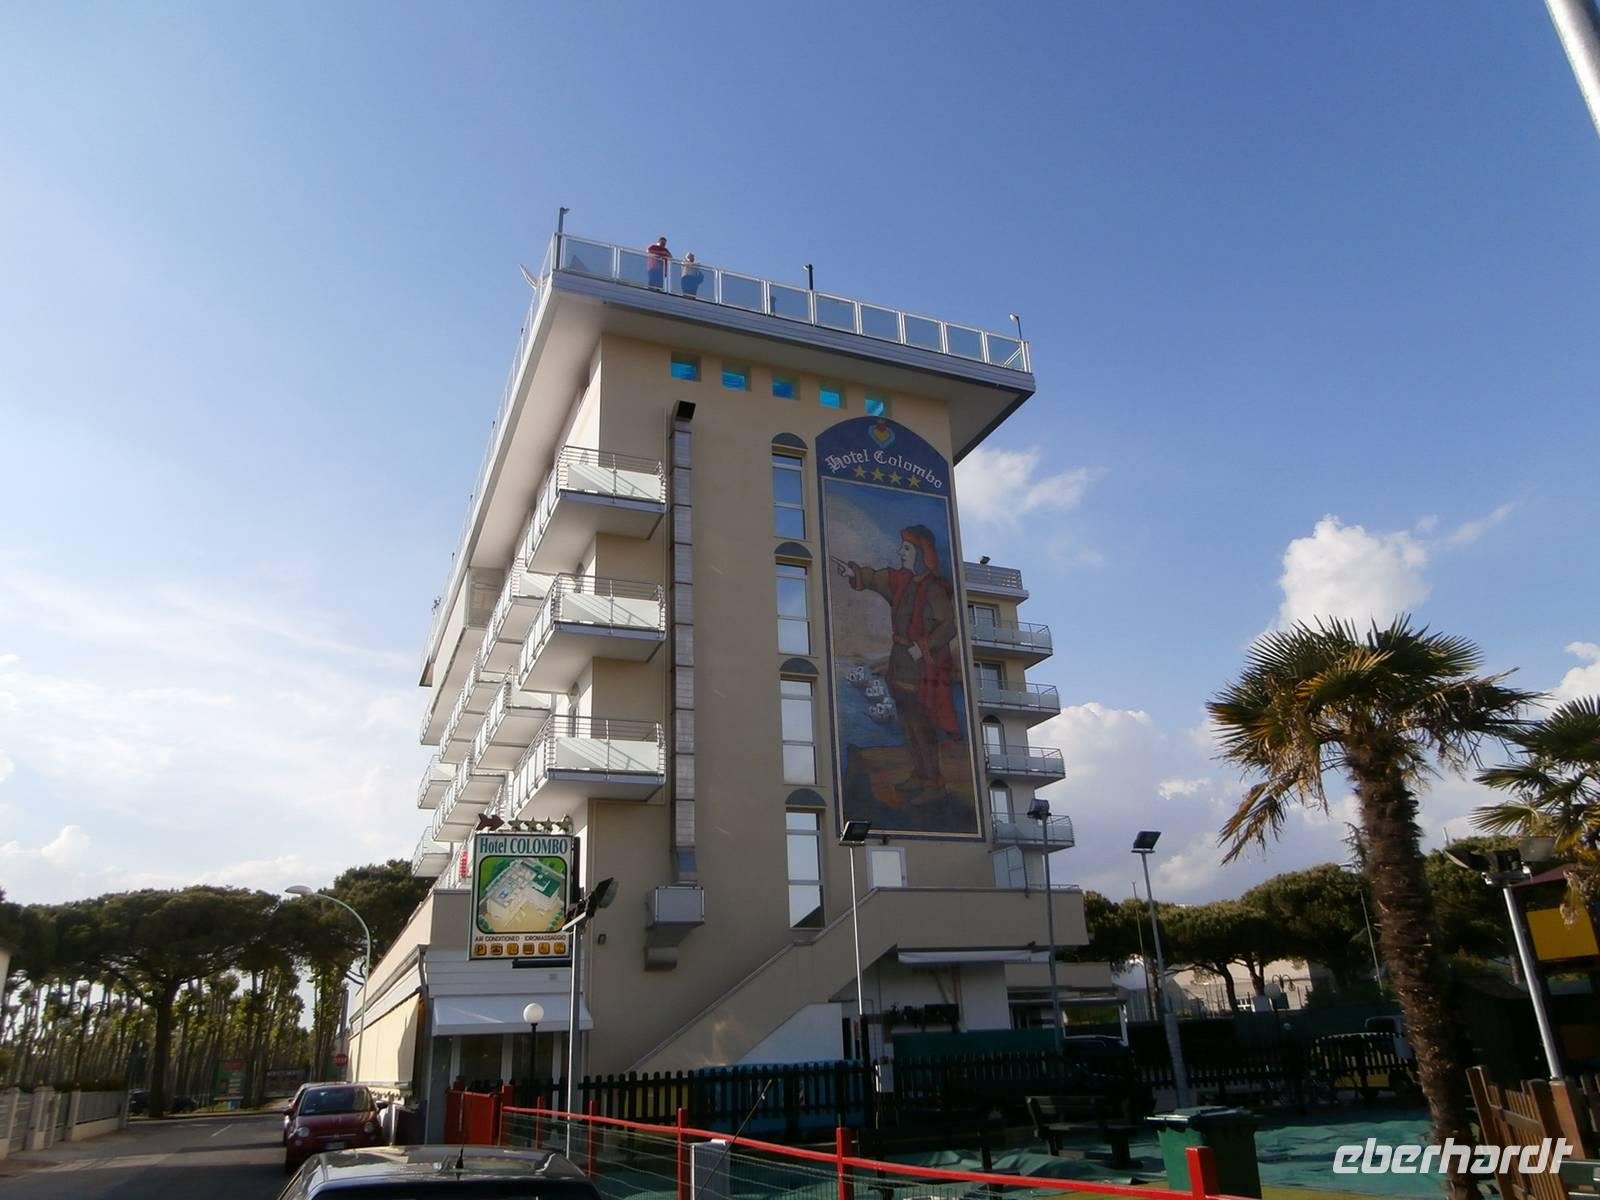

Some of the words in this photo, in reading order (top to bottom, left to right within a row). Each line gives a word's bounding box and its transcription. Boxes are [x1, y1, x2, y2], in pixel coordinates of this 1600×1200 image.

[825, 449, 869, 474] Hotel
[873, 450, 943, 489] Colombo
[480, 837, 507, 854] Hotel
[510, 837, 568, 854] COLOMBO
